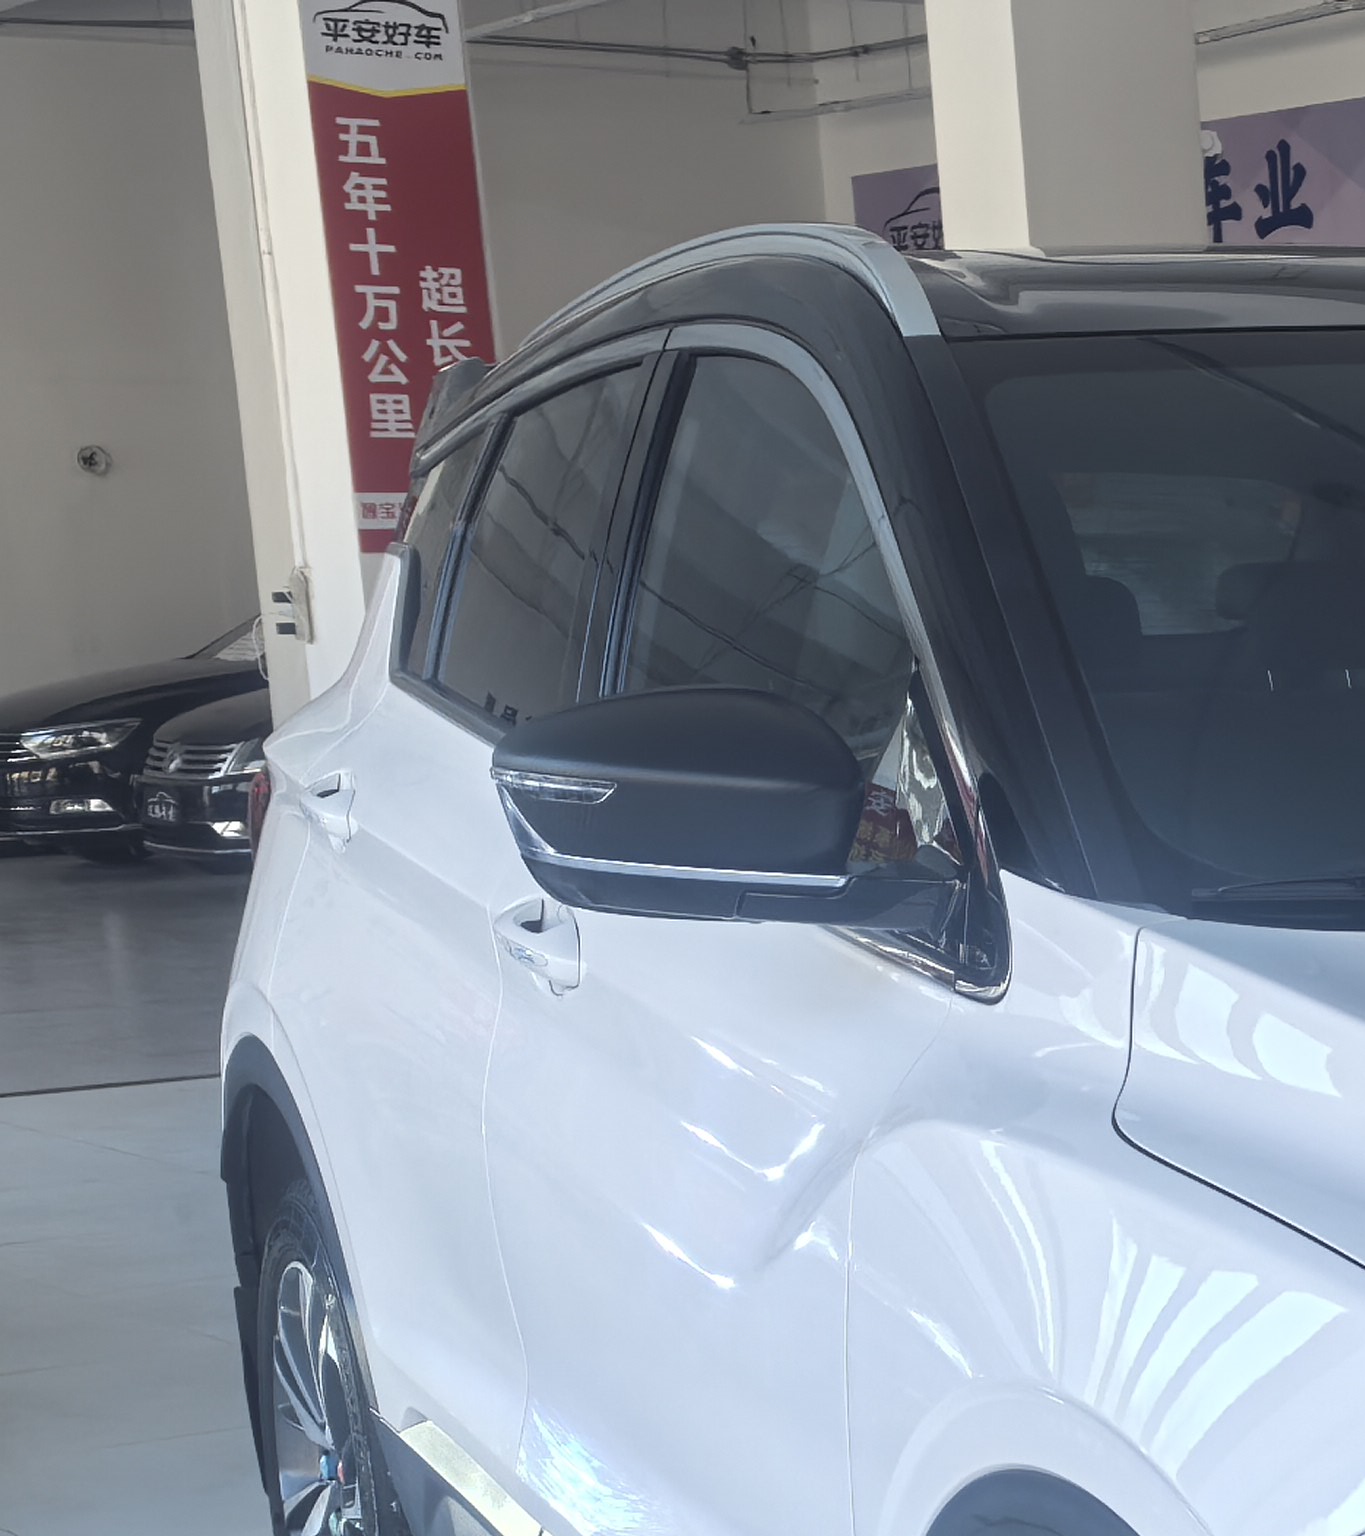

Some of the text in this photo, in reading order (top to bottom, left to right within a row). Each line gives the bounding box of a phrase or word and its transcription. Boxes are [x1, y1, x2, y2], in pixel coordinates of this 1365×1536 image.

[320, 17, 442, 48] 平安好车
[335, 116, 417, 439] 五年十万公里
